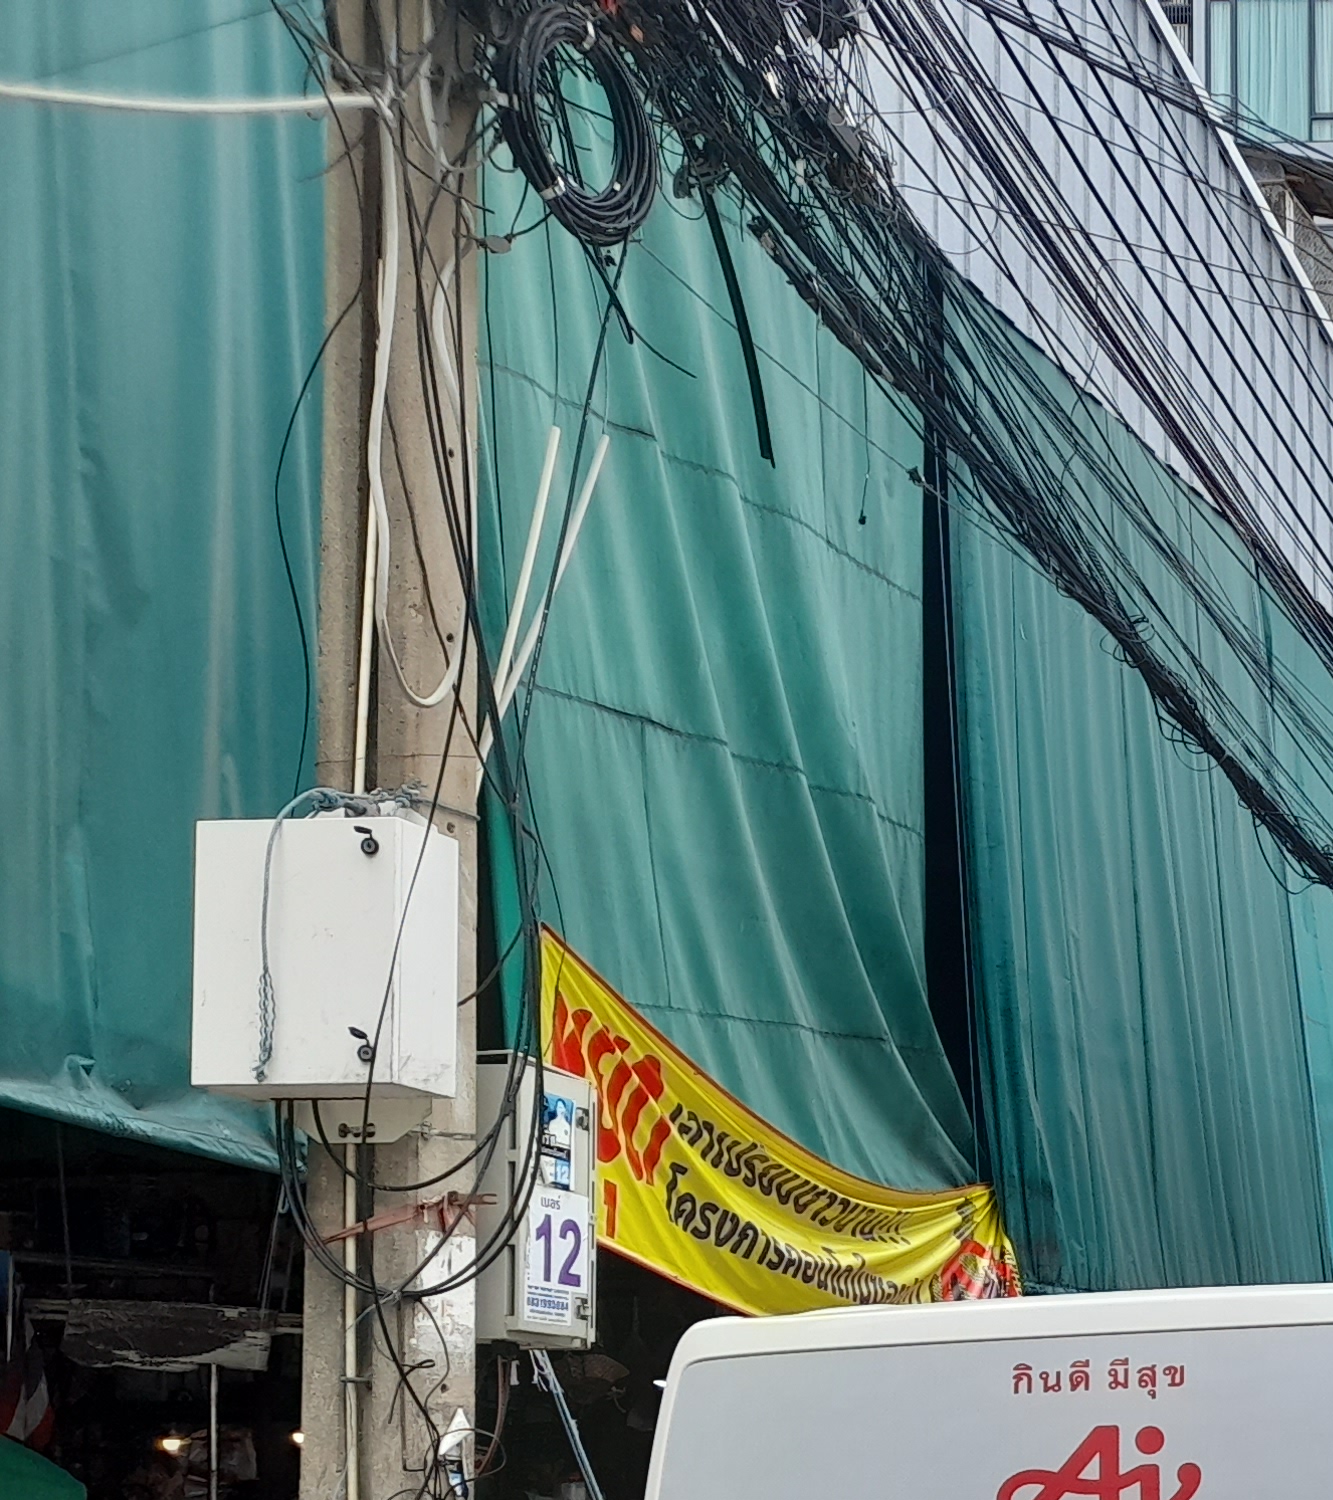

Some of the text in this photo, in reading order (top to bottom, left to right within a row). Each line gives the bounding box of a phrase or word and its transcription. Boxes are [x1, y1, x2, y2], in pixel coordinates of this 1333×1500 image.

[540, 1194, 561, 1210] เบอร์
[535, 1214, 581, 1287] 12
[1012, 1357, 1185, 1400] กินดี มีสุข
